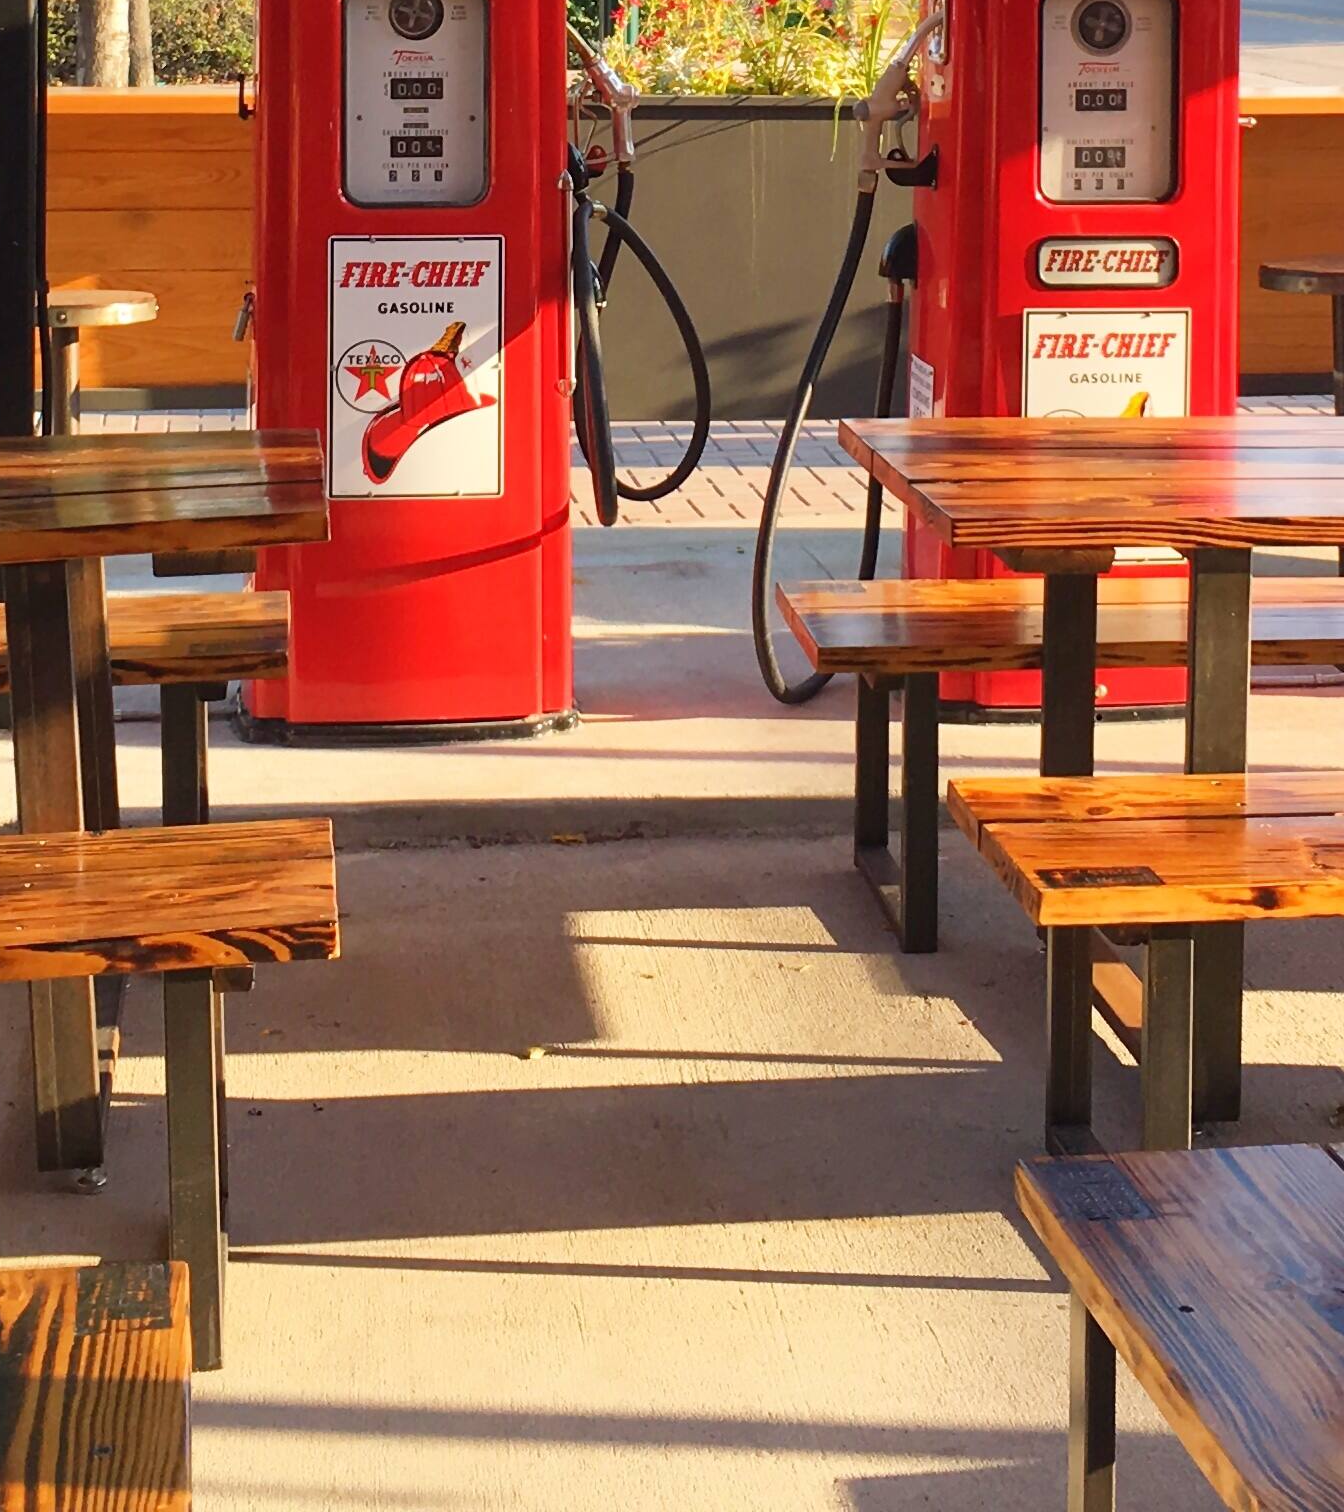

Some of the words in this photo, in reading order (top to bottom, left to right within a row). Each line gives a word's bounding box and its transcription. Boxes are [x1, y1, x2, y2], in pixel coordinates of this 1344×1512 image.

[1044, 249, 1170, 273] FIRE-CHIEF
[340, 260, 491, 289] FIRE-CHIEF
[377, 302, 455, 315] GASOLINE
[1033, 333, 1177, 358] FIRE-CHIEF
[347, 354, 401, 365] TEXACO
[360, 367, 385, 390] T
[1069, 373, 1143, 385] GASOLINE
